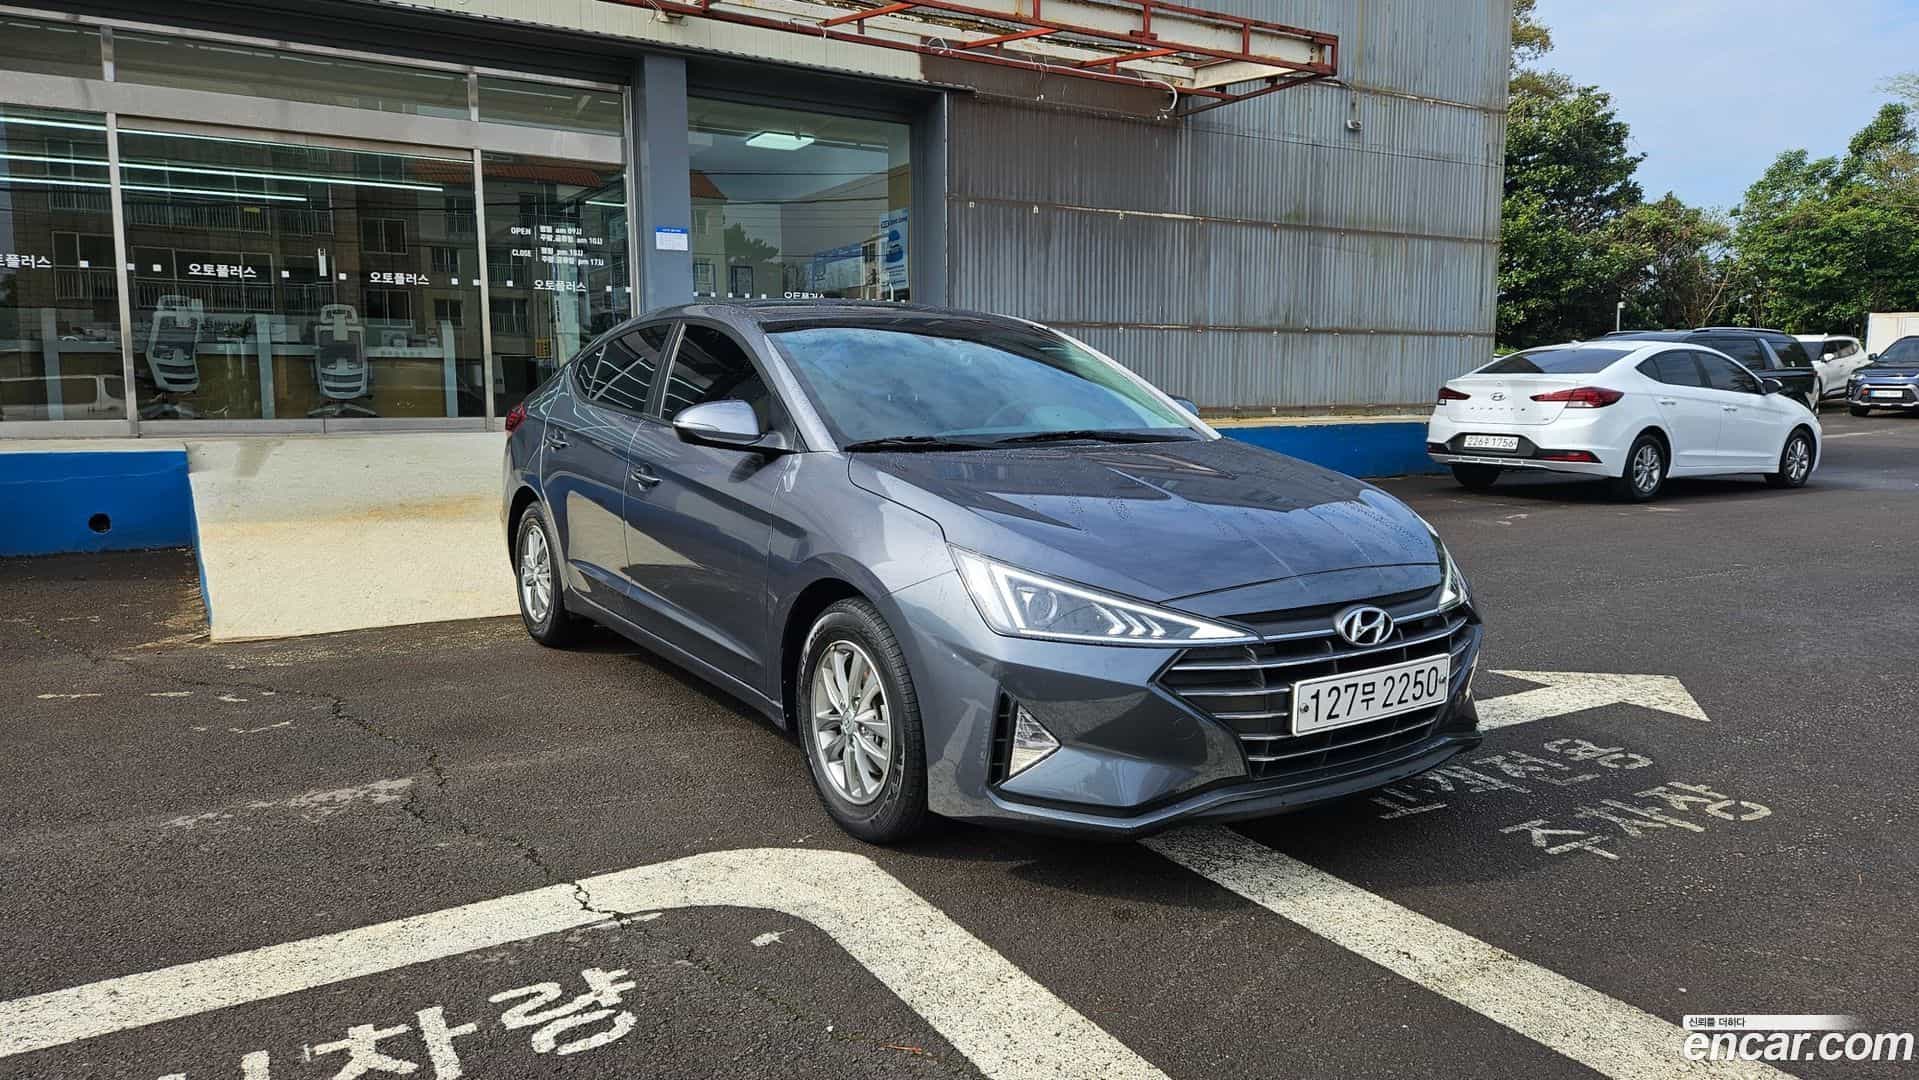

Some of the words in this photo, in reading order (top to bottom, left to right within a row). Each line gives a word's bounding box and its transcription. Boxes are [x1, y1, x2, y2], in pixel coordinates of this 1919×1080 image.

[511, 226, 531, 235] OPEN
[512, 248, 532, 257] CLOSE
[188, 263, 258, 279] 오토플러스
[369, 271, 430, 286] 오토플러스
[534, 279, 587, 293] 오토플러스
[1310, 681, 1376, 722] 127무
[1382, 666, 1439, 709] 2250
[1499, 781, 1773, 860] 주차장
